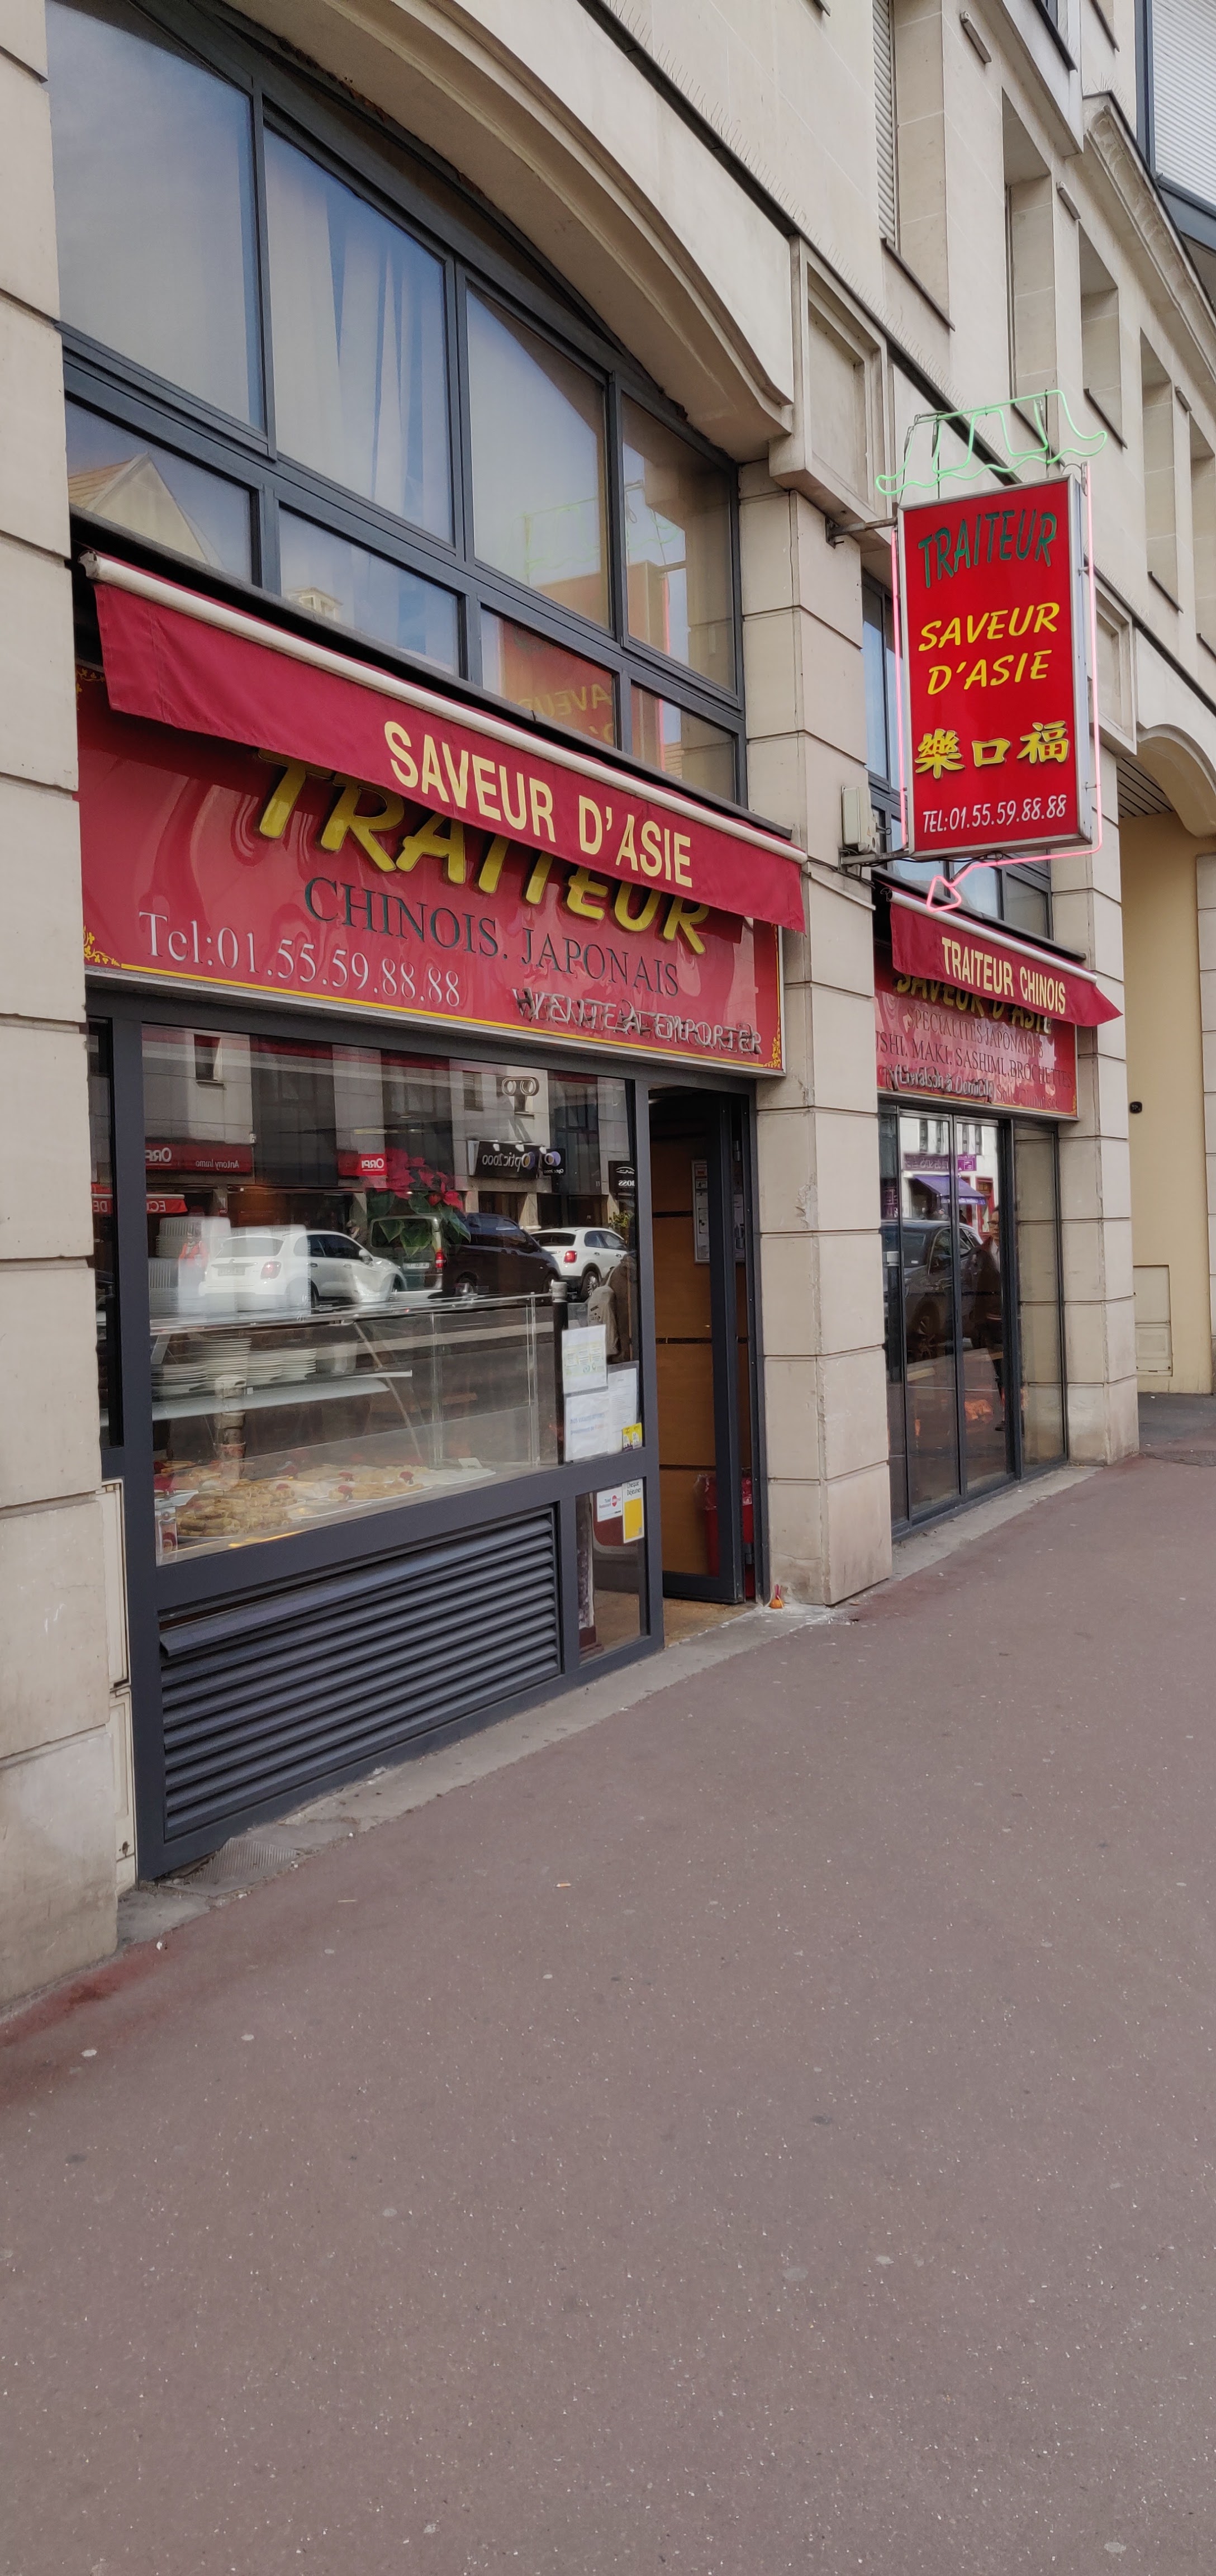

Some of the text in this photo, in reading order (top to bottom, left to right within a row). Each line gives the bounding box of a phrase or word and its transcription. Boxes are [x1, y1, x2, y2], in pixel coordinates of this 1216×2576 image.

[918, 508, 1057, 589] TRAITEUR
[918, 602, 1060, 652] SAVEUR
[927, 649, 1053, 695] D'ASIE
[914, 721, 1070, 780] 樂口福
[384, 721, 693, 888] SAVEUR D'ASIE
[922, 793, 1068, 834] TEL:01.55.59.88.88
[139, 911, 460, 1008] Tel:01.55.59.88.88
[521, 927, 680, 997] JAPONAIS
[941, 936, 1066, 1015] TRAITEUR CHINOIS
[654, 1012, 763, 1056] EMPORTER
[992, 1001, 1052, 1035] DASIE
